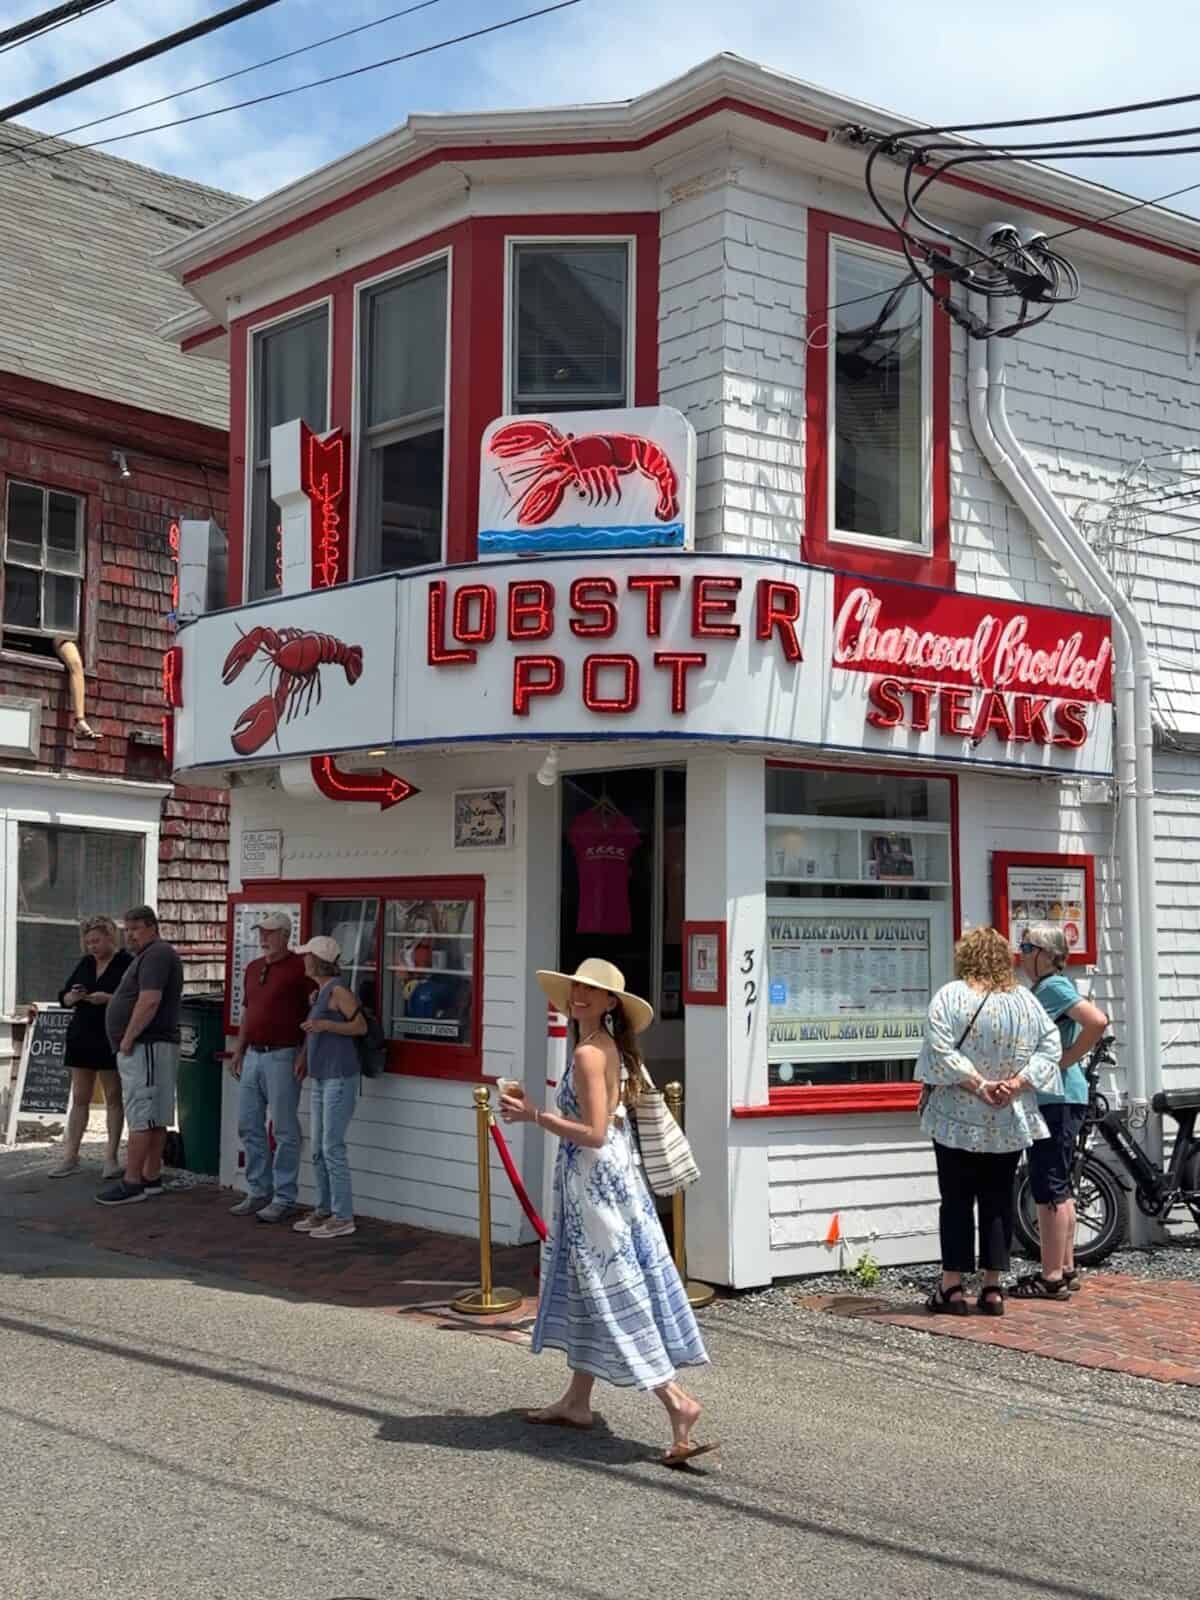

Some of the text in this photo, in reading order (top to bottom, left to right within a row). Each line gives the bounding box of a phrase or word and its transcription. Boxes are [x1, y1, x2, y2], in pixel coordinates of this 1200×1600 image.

[427, 575, 803, 666] LOBSTER
[833, 587, 1114, 700] Charcoal Broiled
[512, 652, 707, 716] POT
[866, 678, 1089, 748] STEAKS
[769, 920, 927, 941] WATERFRONT DINING
[740, 948, 757, 1037] 321
[31, 1040, 66, 1056] OPE
[769, 1022, 797, 1042] FULL
[882, 1022, 902, 1039] ALL
